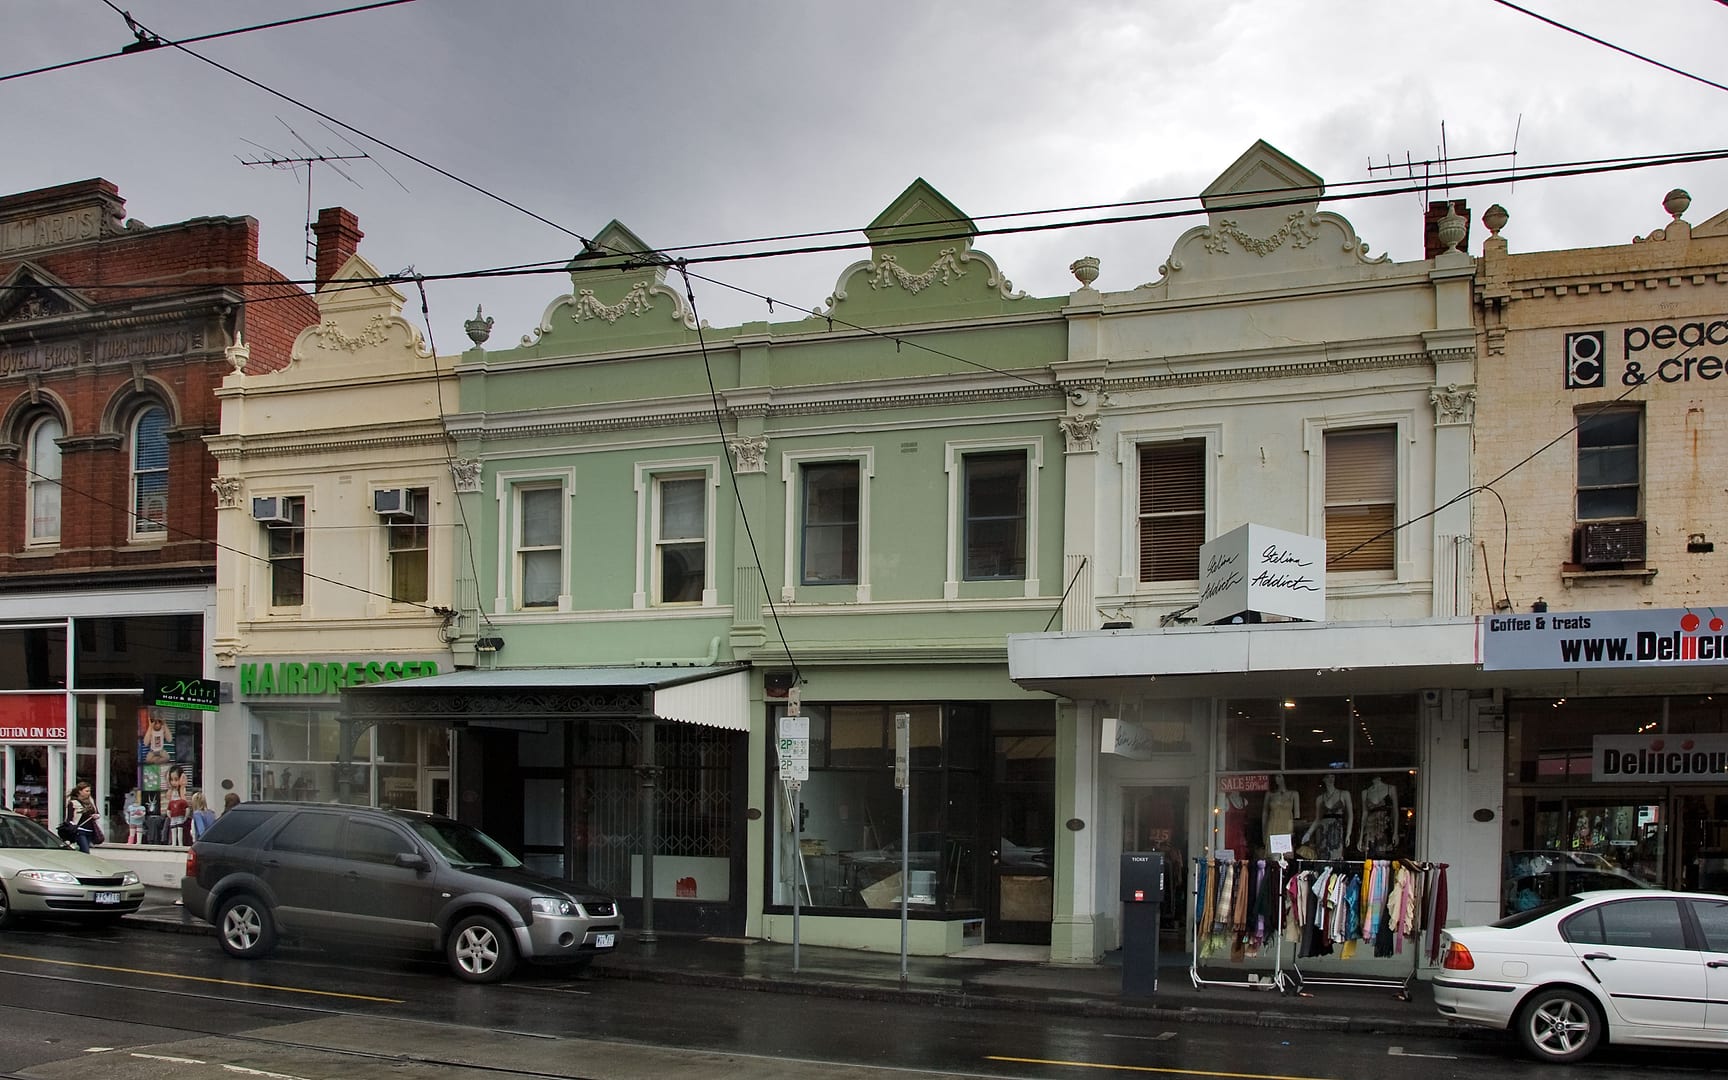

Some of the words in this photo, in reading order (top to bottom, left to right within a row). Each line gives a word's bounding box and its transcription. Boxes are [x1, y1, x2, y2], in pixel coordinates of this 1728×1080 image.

[1622, 361, 1647, 386] &
[1658, 355, 1728, 384] cre
[1251, 570, 1321, 591] Addict
[1490, 618, 1531, 632] Coffee
[1535, 617, 1546, 630] &
[1552, 616, 1591, 630] treats
[161, 680, 216, 698] Nutri
[30, 728, 44, 737] ON
[46, 727, 66, 738] KIDS
[780, 740, 793, 750] 2P
[780, 760, 793, 770] 2P
[1221, 777, 1245, 790] SALE
